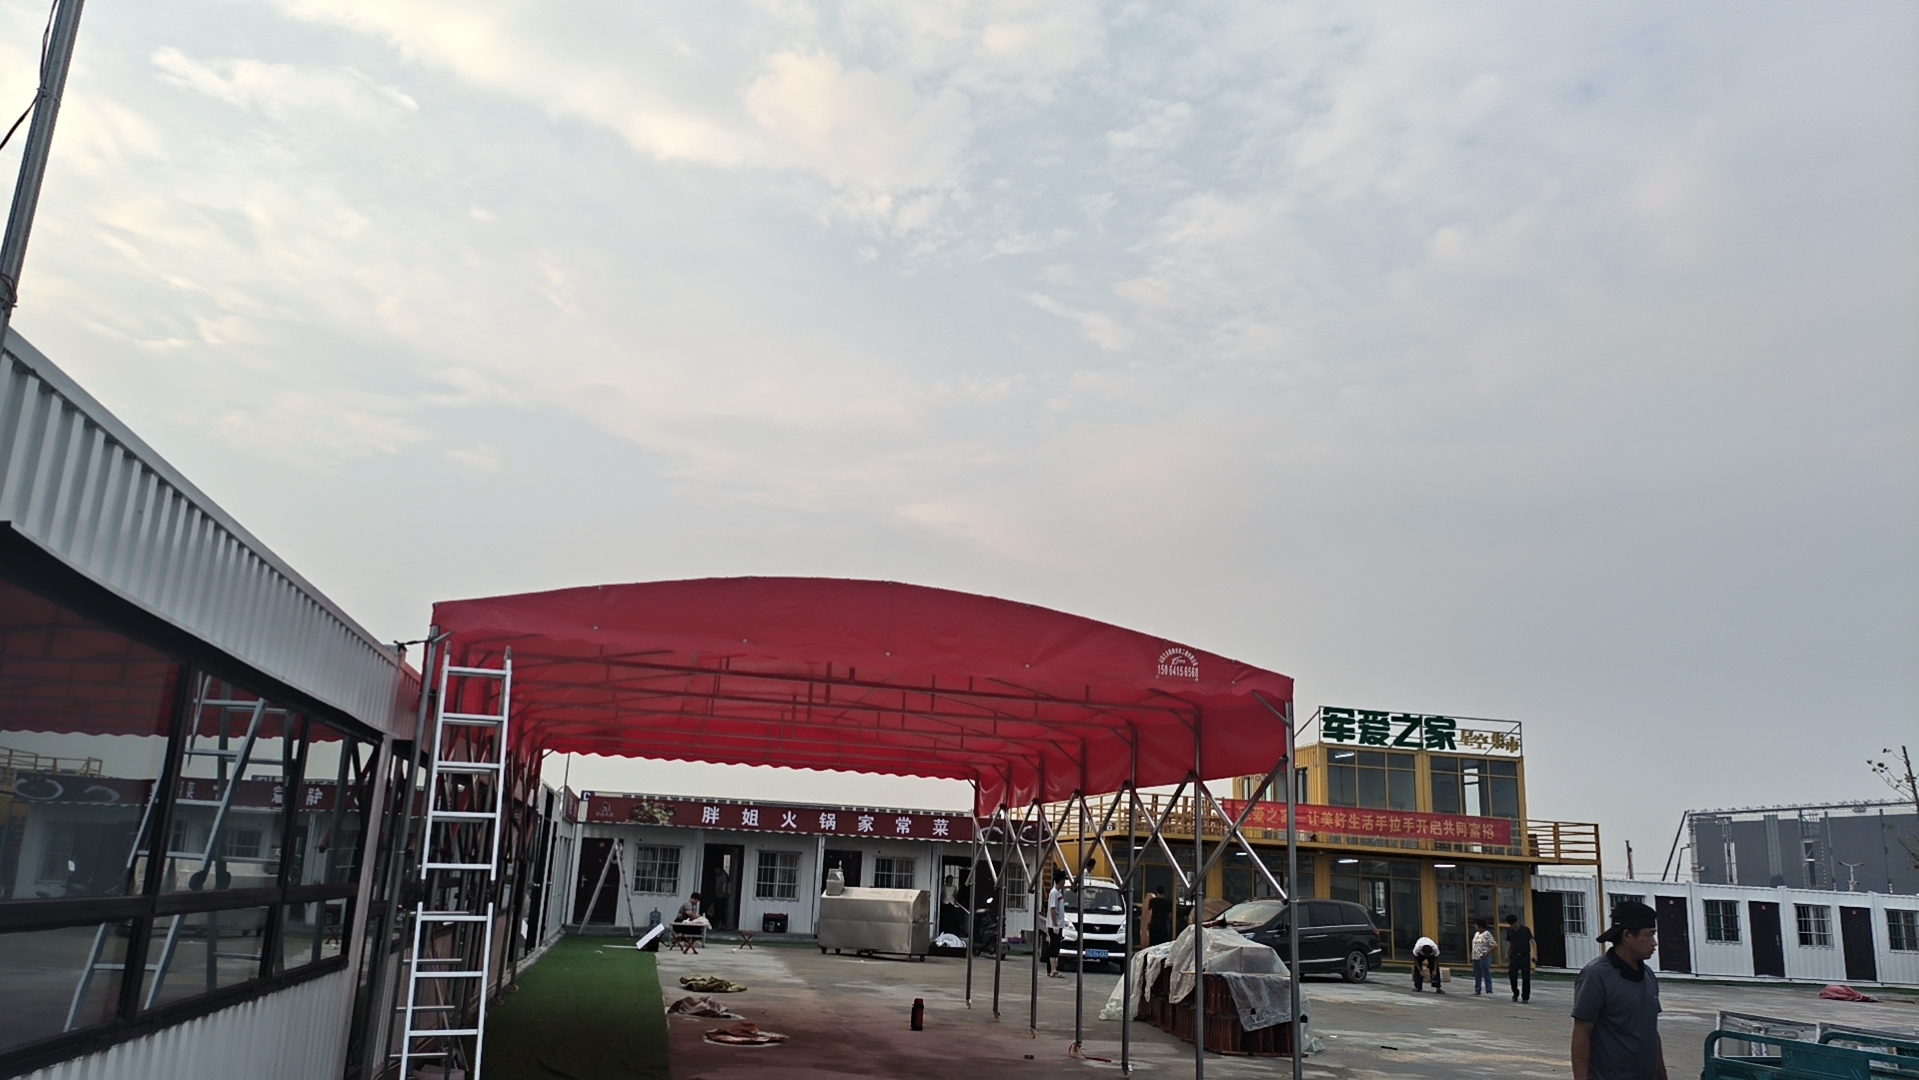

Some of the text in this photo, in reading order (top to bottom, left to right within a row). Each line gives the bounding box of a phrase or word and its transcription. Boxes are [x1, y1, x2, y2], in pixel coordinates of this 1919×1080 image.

[1322, 706, 1457, 750] 军爱之家
[701, 805, 950, 837] 胖姐火锅家常菜
